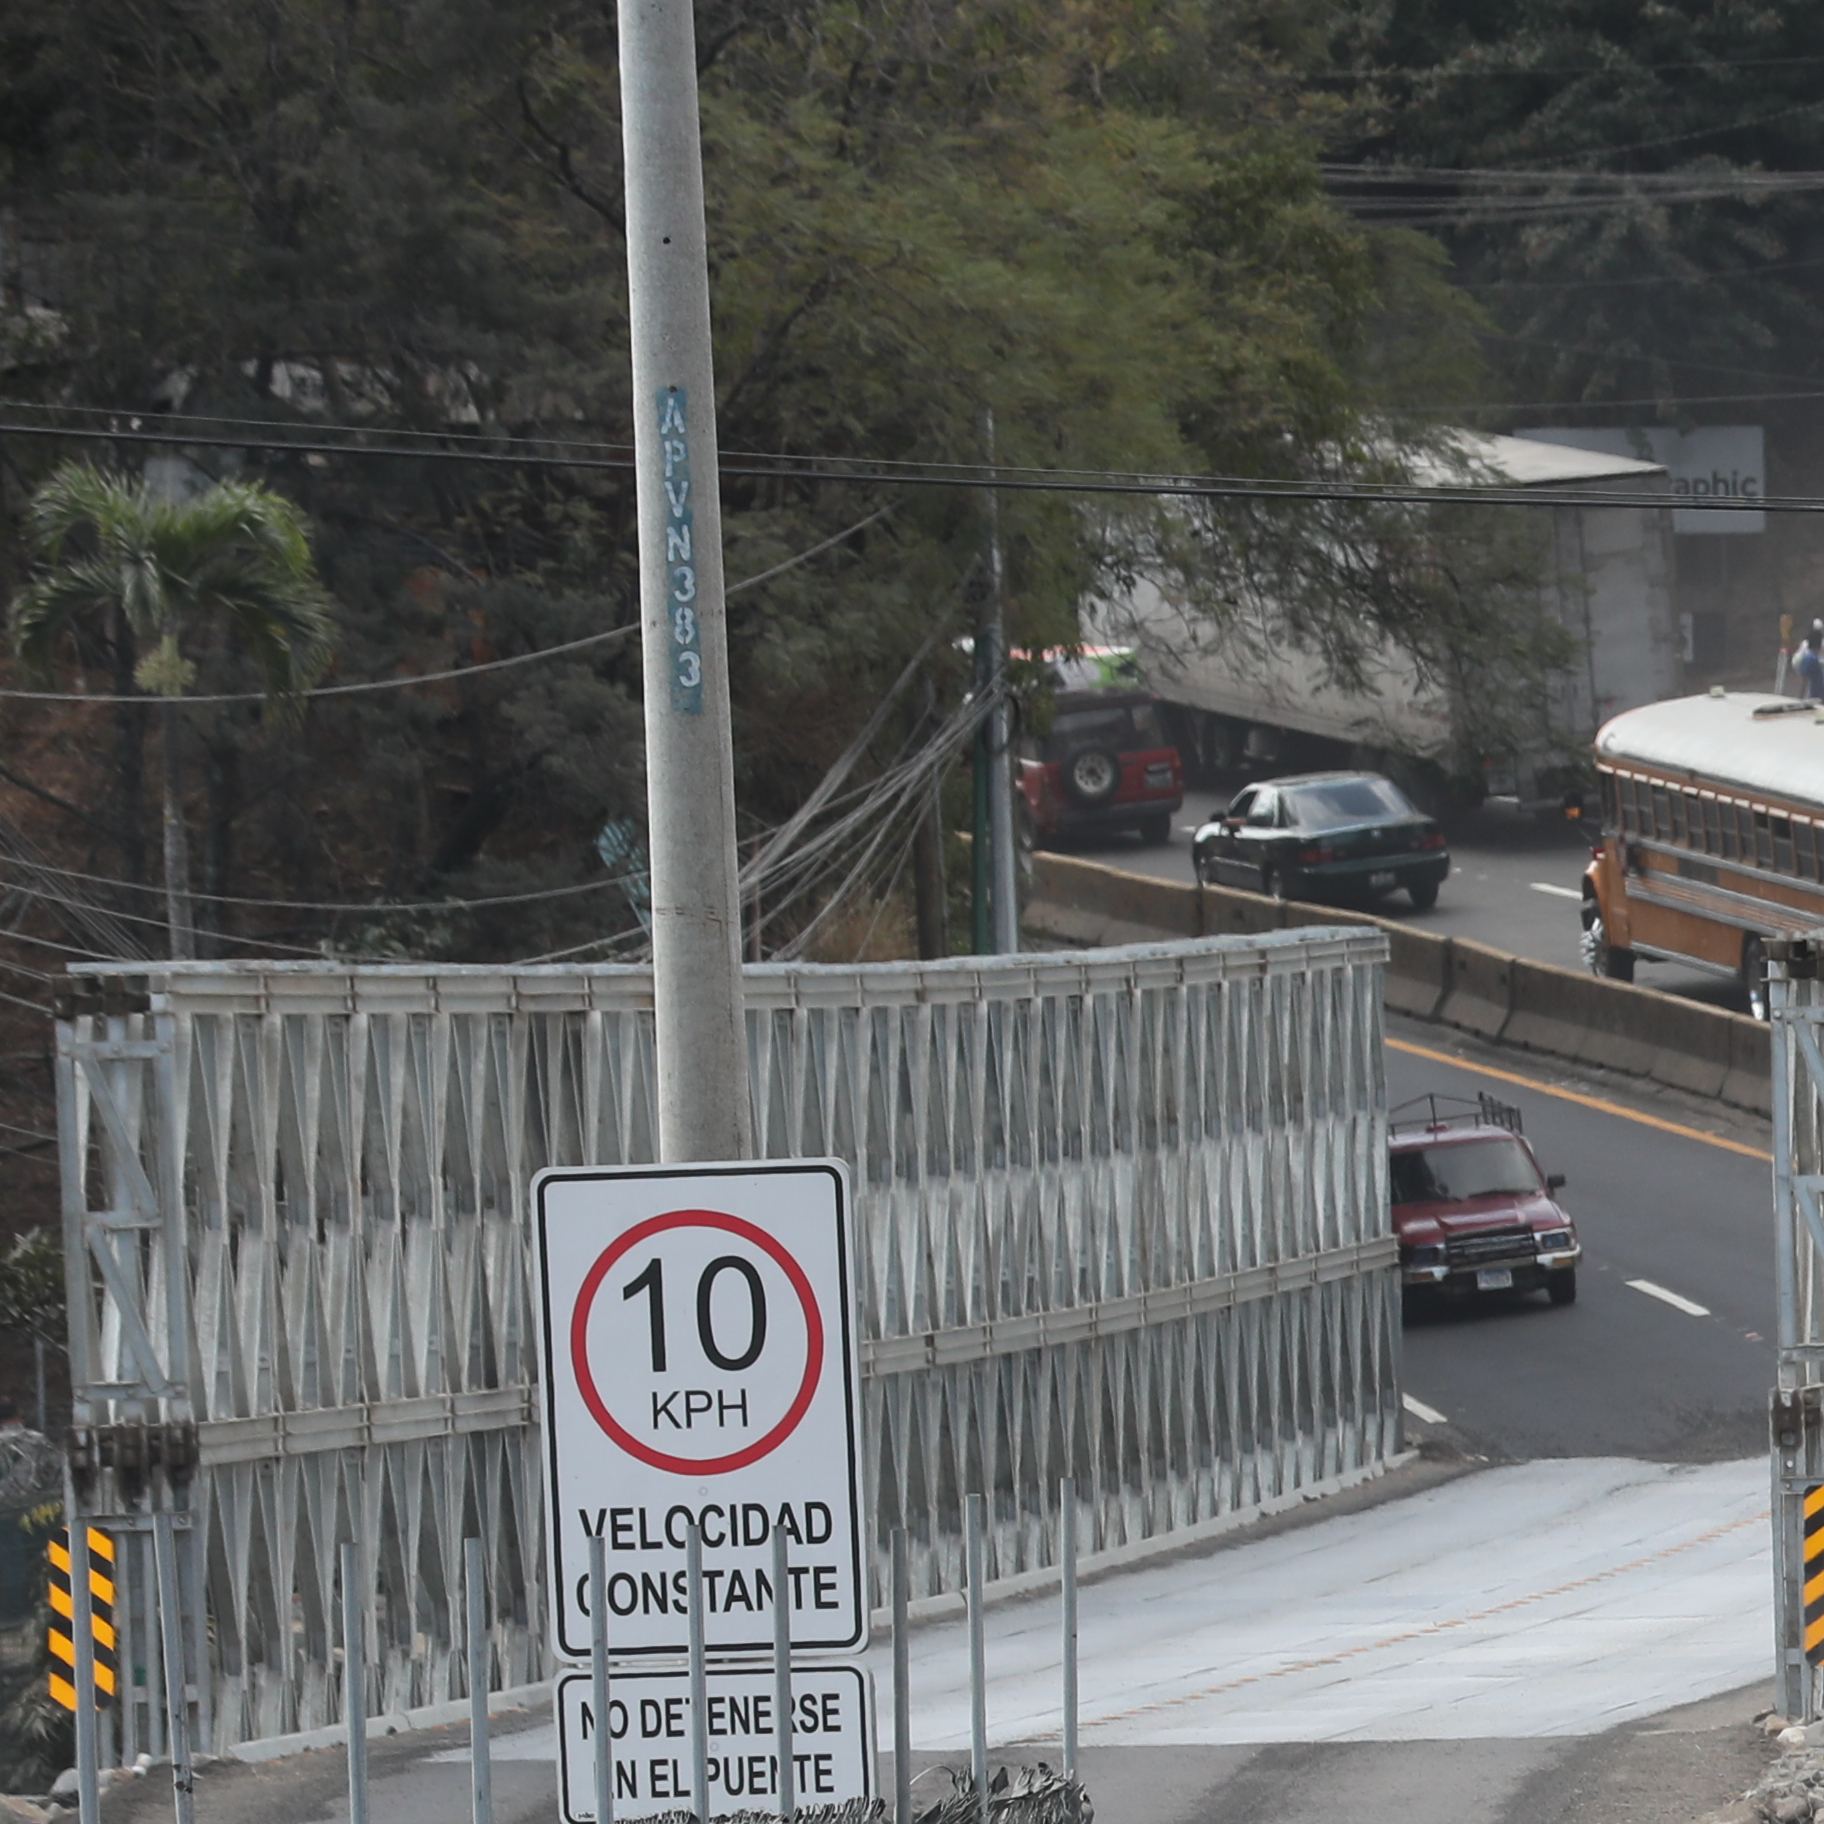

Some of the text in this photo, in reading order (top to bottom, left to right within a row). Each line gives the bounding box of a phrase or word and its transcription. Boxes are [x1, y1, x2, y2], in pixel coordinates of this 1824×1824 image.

[660, 397, 701, 688] APVN383
[622, 1255, 767, 1373] 10
[651, 1388, 749, 1430] KPH
[578, 1502, 833, 1550] VELOCIDAD
[650, 1759, 691, 1798] EL
